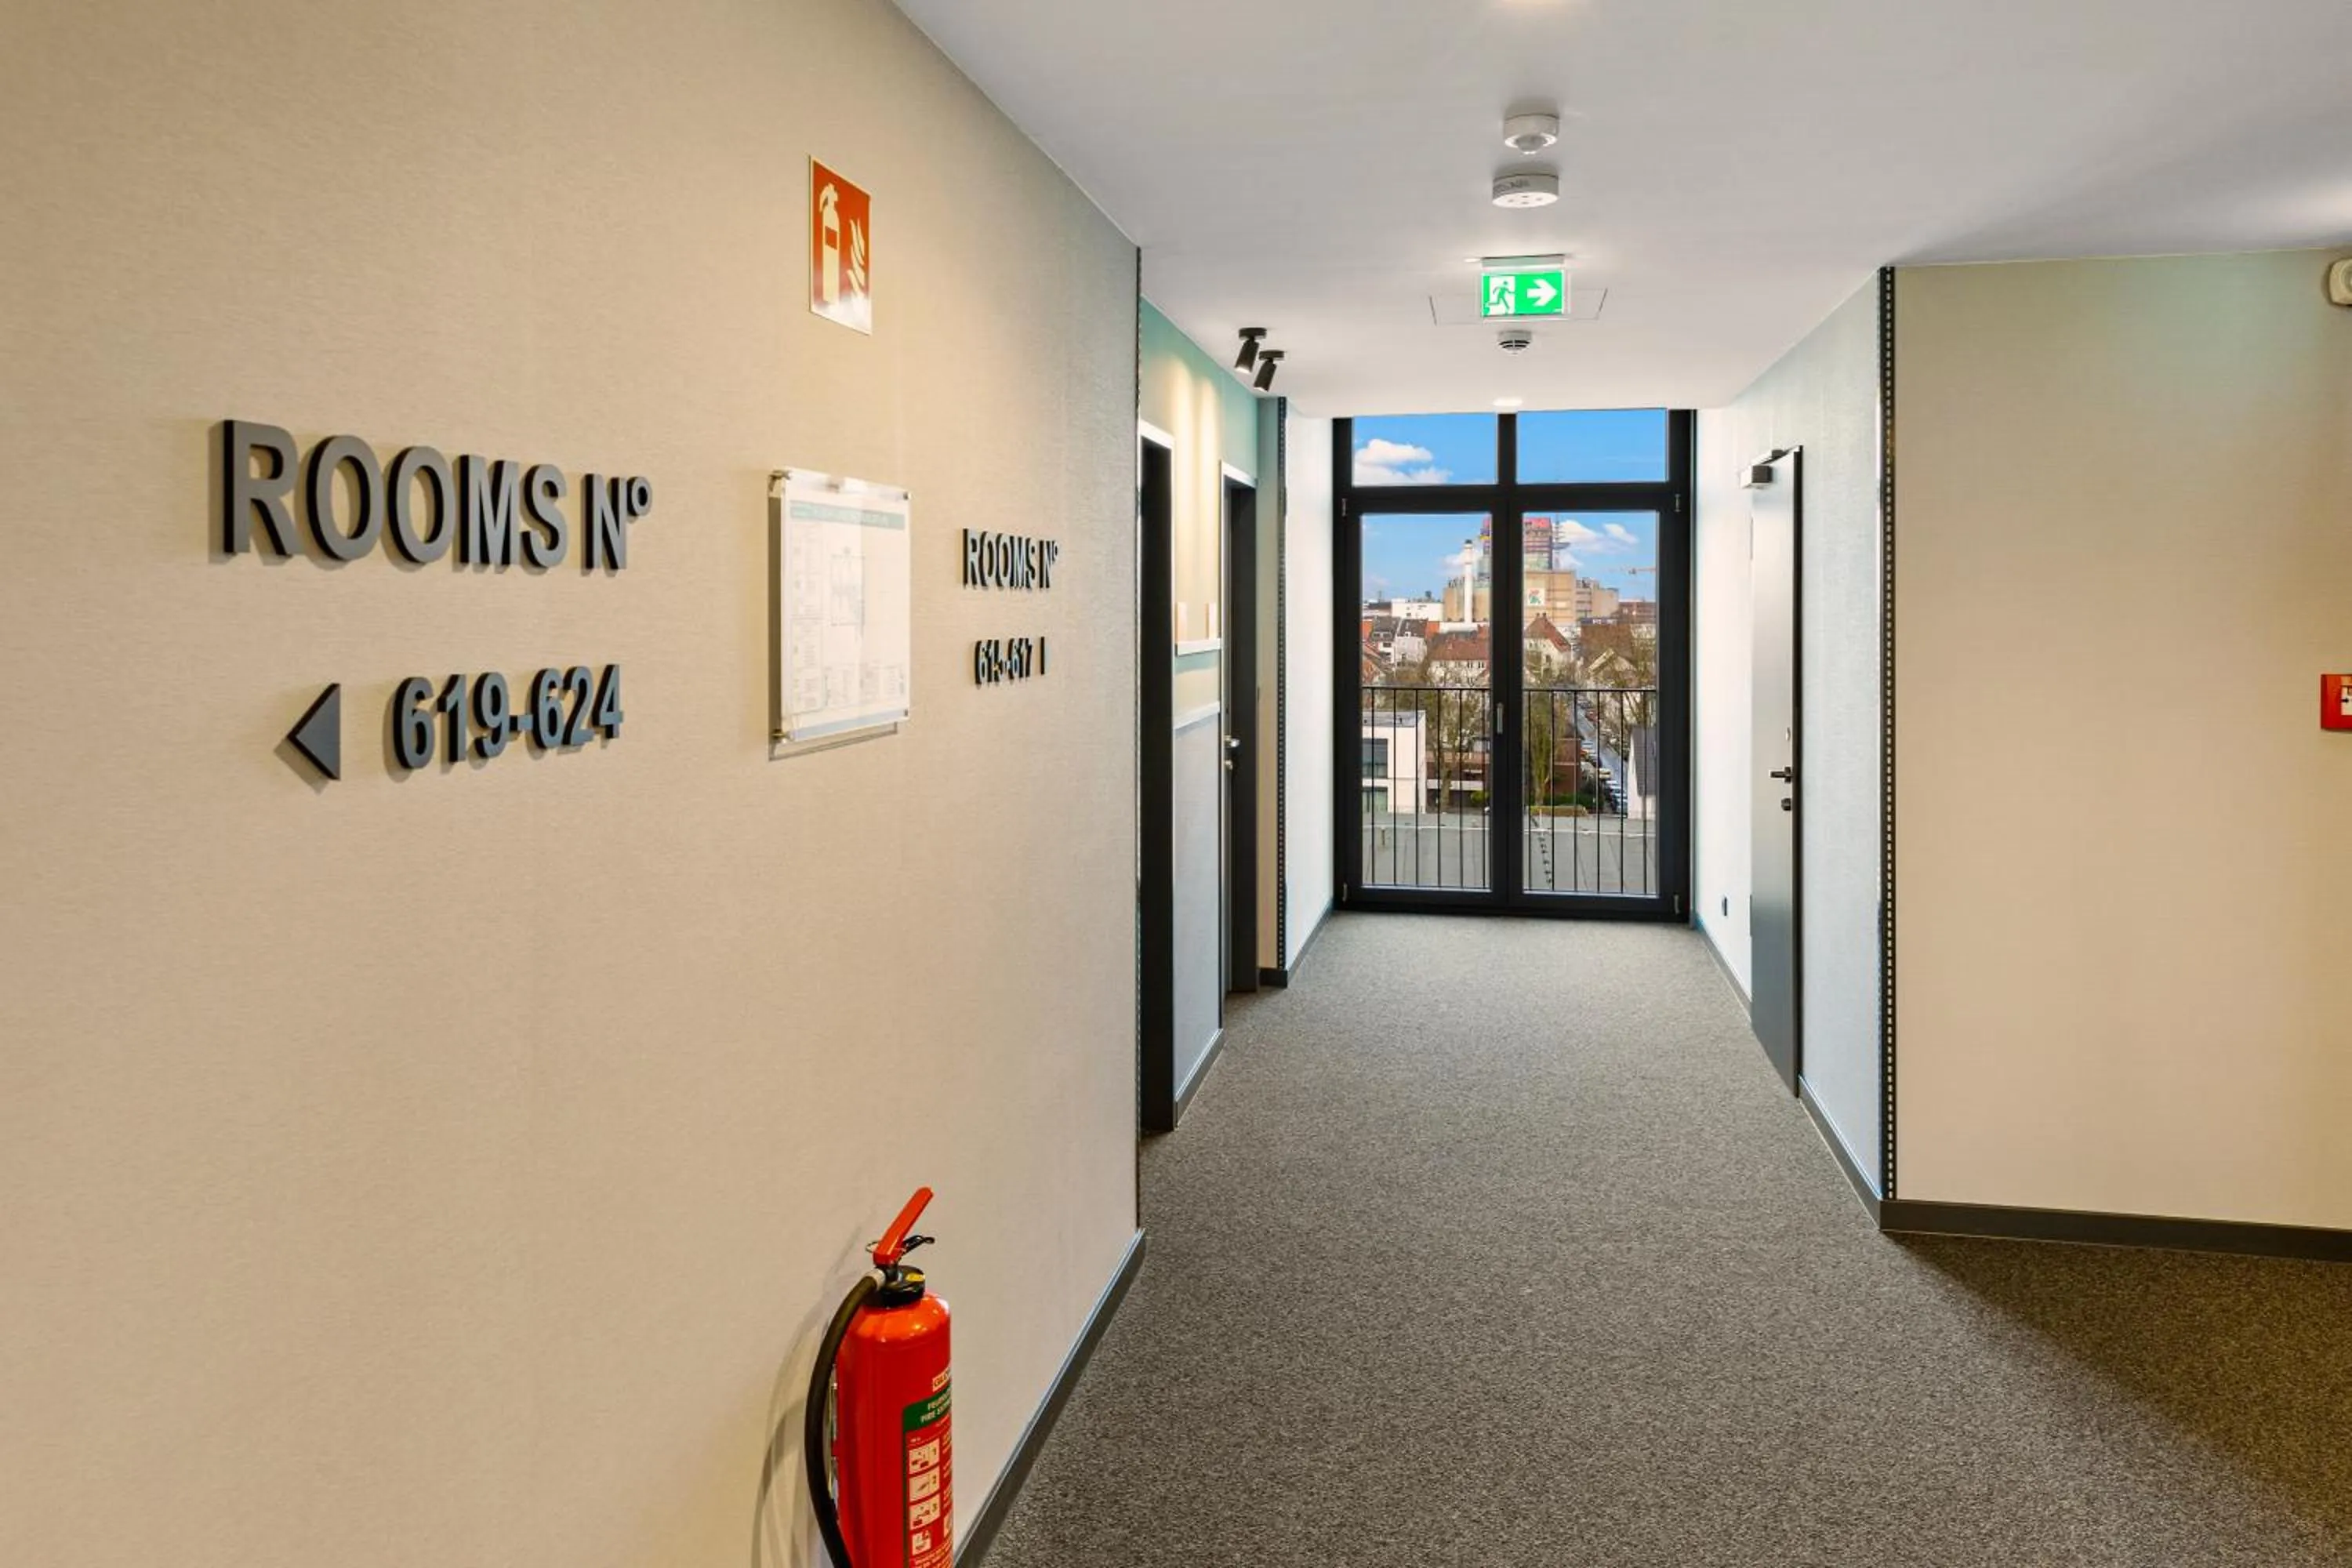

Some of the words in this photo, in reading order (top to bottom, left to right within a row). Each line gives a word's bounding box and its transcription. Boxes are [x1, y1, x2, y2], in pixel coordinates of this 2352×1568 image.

[223, 419, 568, 568] ROOMS
[963, 528, 1036, 589] ROOMS
[393, 664, 623, 769] 619-624
